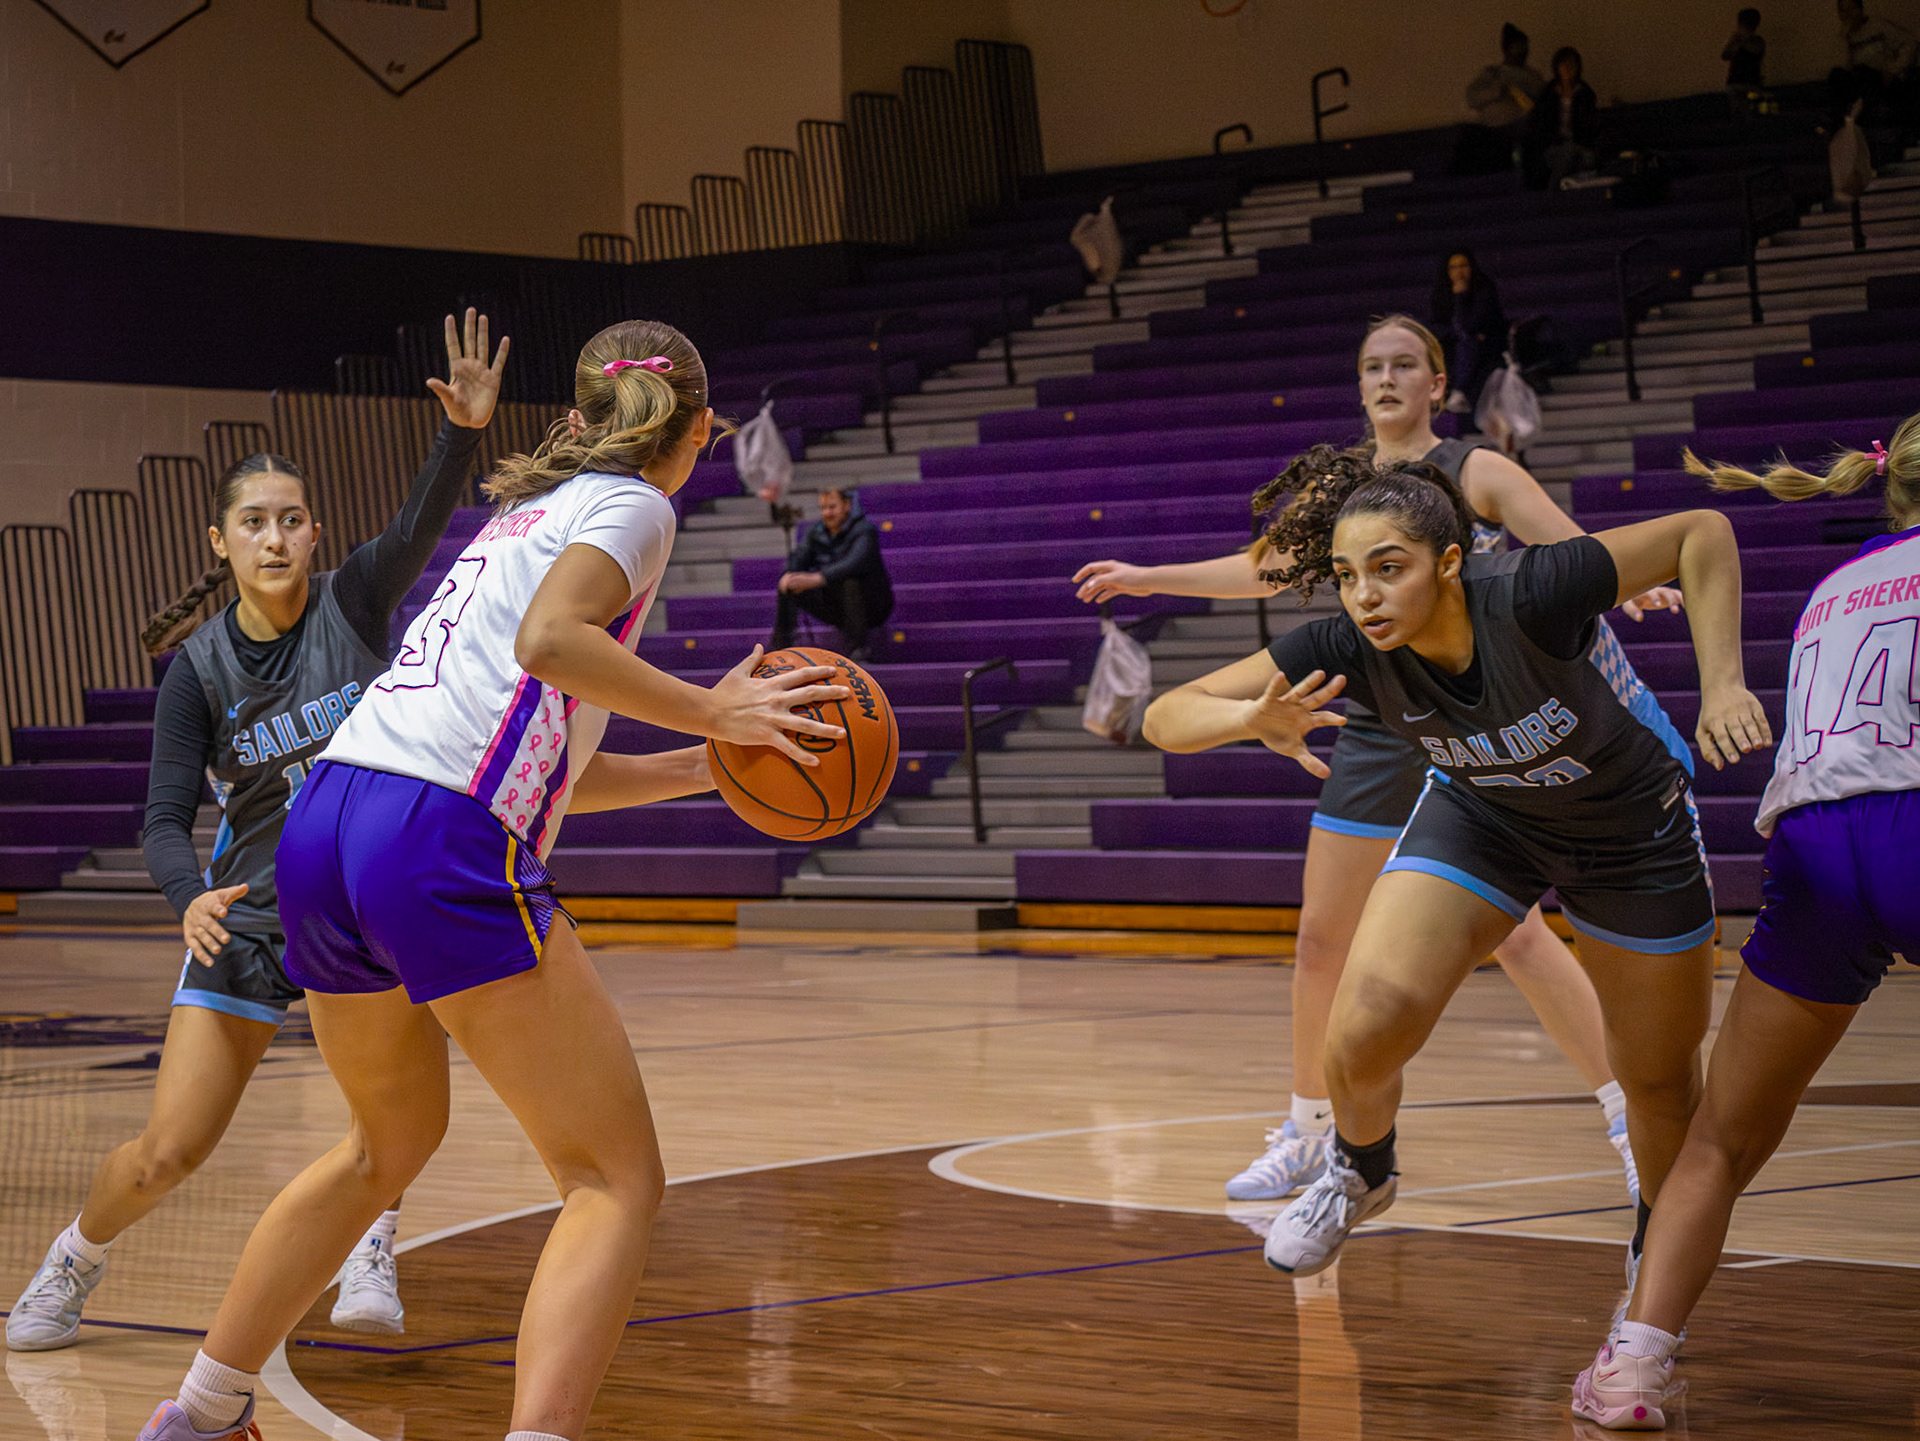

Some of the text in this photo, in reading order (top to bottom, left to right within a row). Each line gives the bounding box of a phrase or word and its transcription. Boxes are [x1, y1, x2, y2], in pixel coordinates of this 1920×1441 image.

[1794, 594, 1840, 642] UNT
[1790, 616, 1920, 775] 14
[1420, 697, 1579, 768] SAILORS
